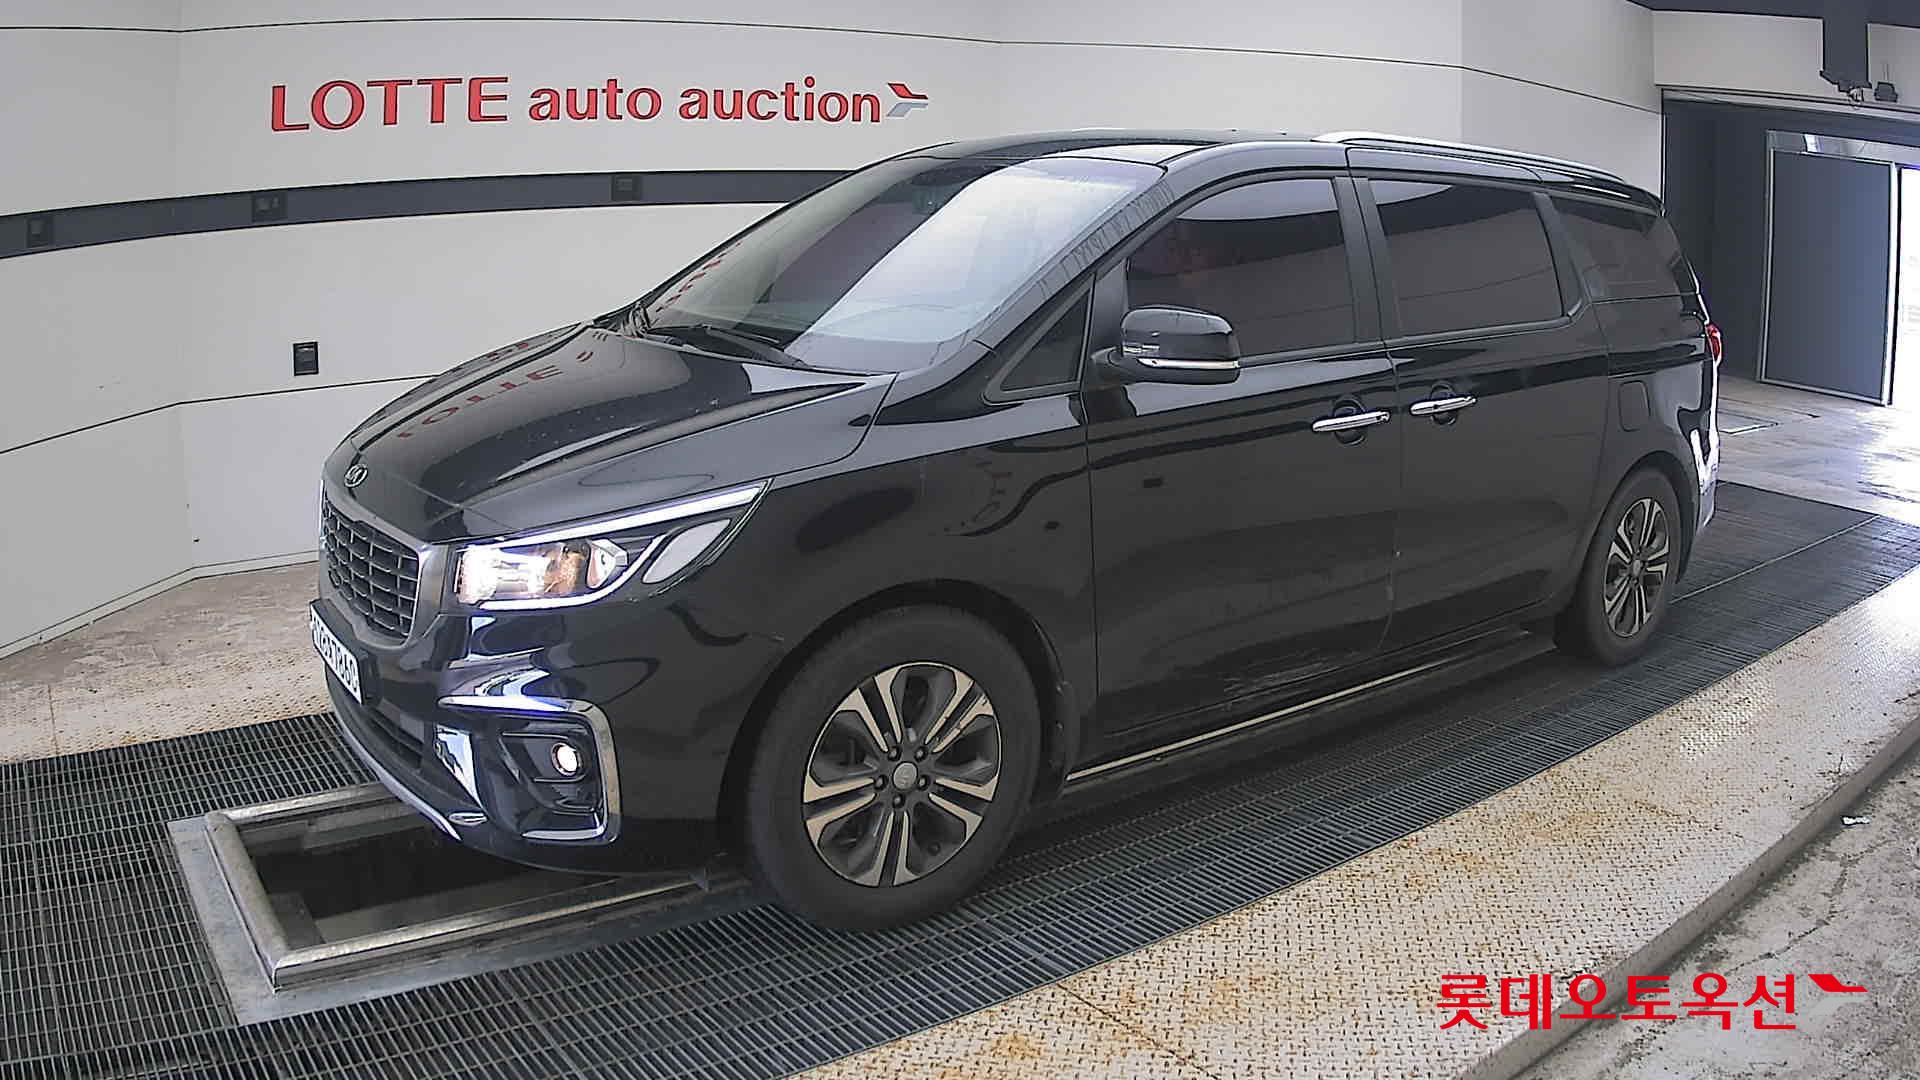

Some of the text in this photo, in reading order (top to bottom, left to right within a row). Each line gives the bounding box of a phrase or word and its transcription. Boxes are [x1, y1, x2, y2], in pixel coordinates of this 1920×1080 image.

[270, 75, 882, 132] LOTTE auto auction
